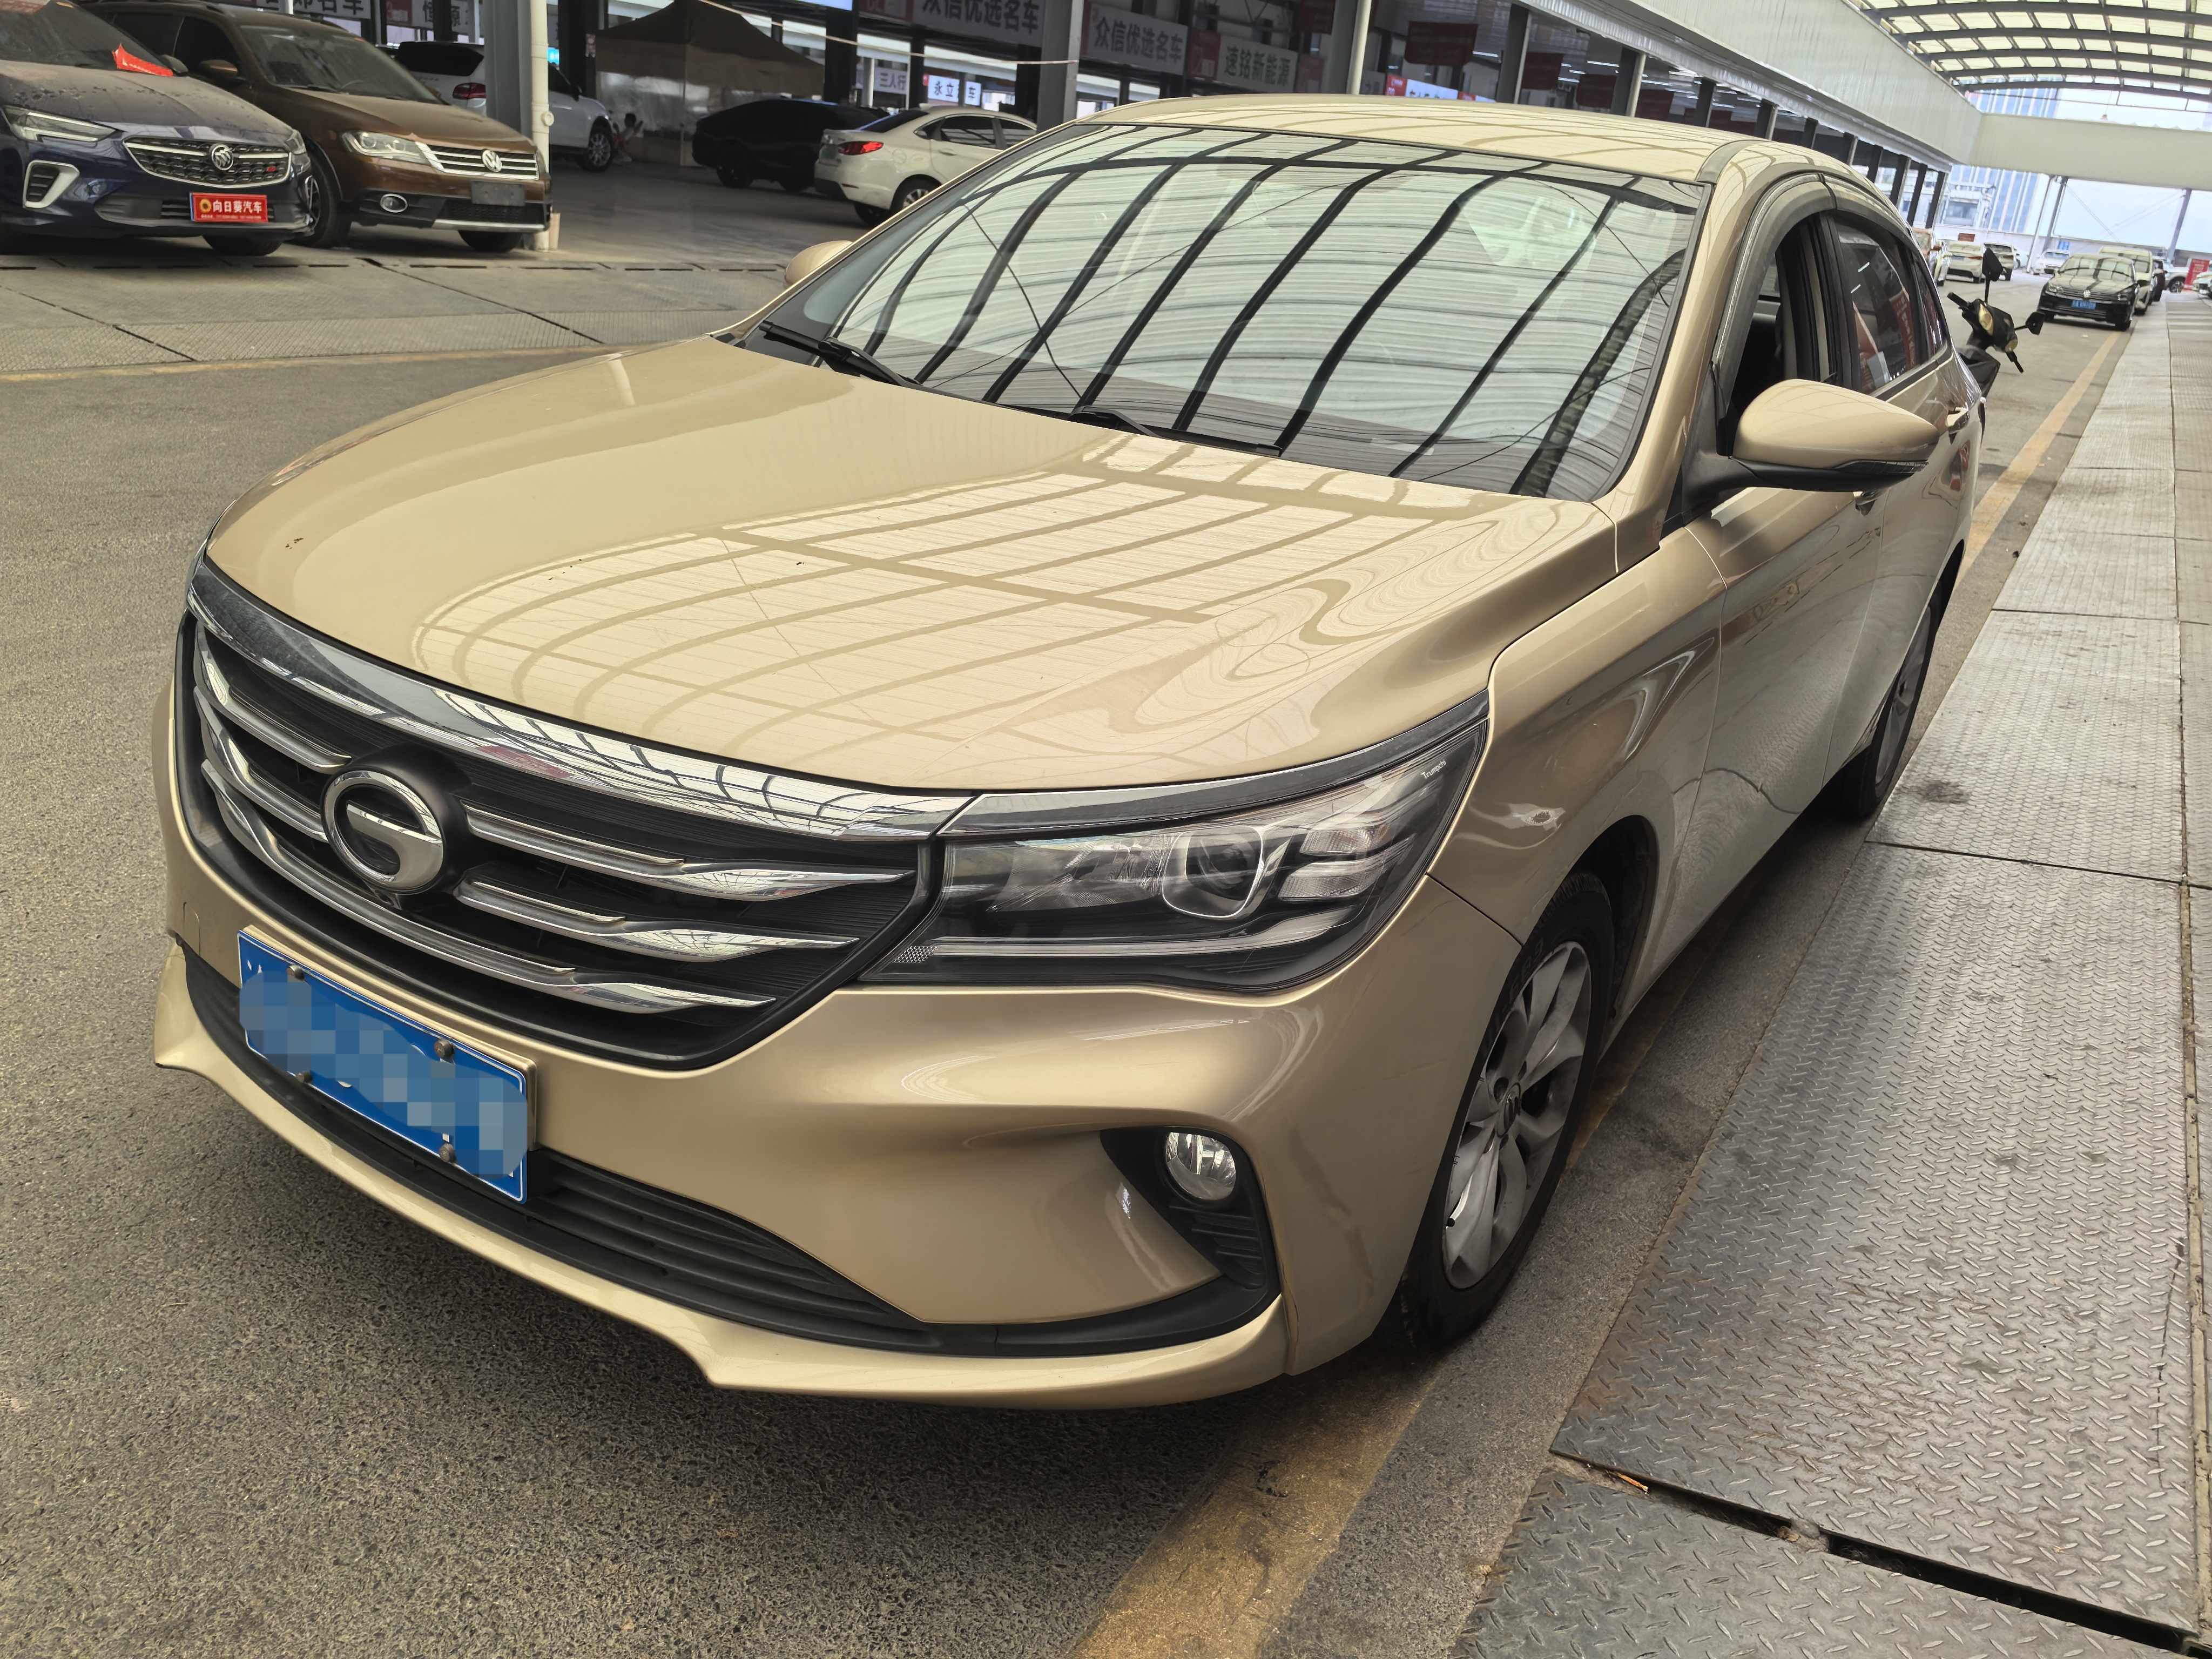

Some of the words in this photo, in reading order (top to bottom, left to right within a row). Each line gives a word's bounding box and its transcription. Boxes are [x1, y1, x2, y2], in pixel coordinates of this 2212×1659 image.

[1094, 17, 1183, 64] 众信优选名车
[934, 80, 976, 99] 永立车
[213, 200, 262, 213] 向日葵汽车
[1421, 759, 1447, 779] Trumpchi
